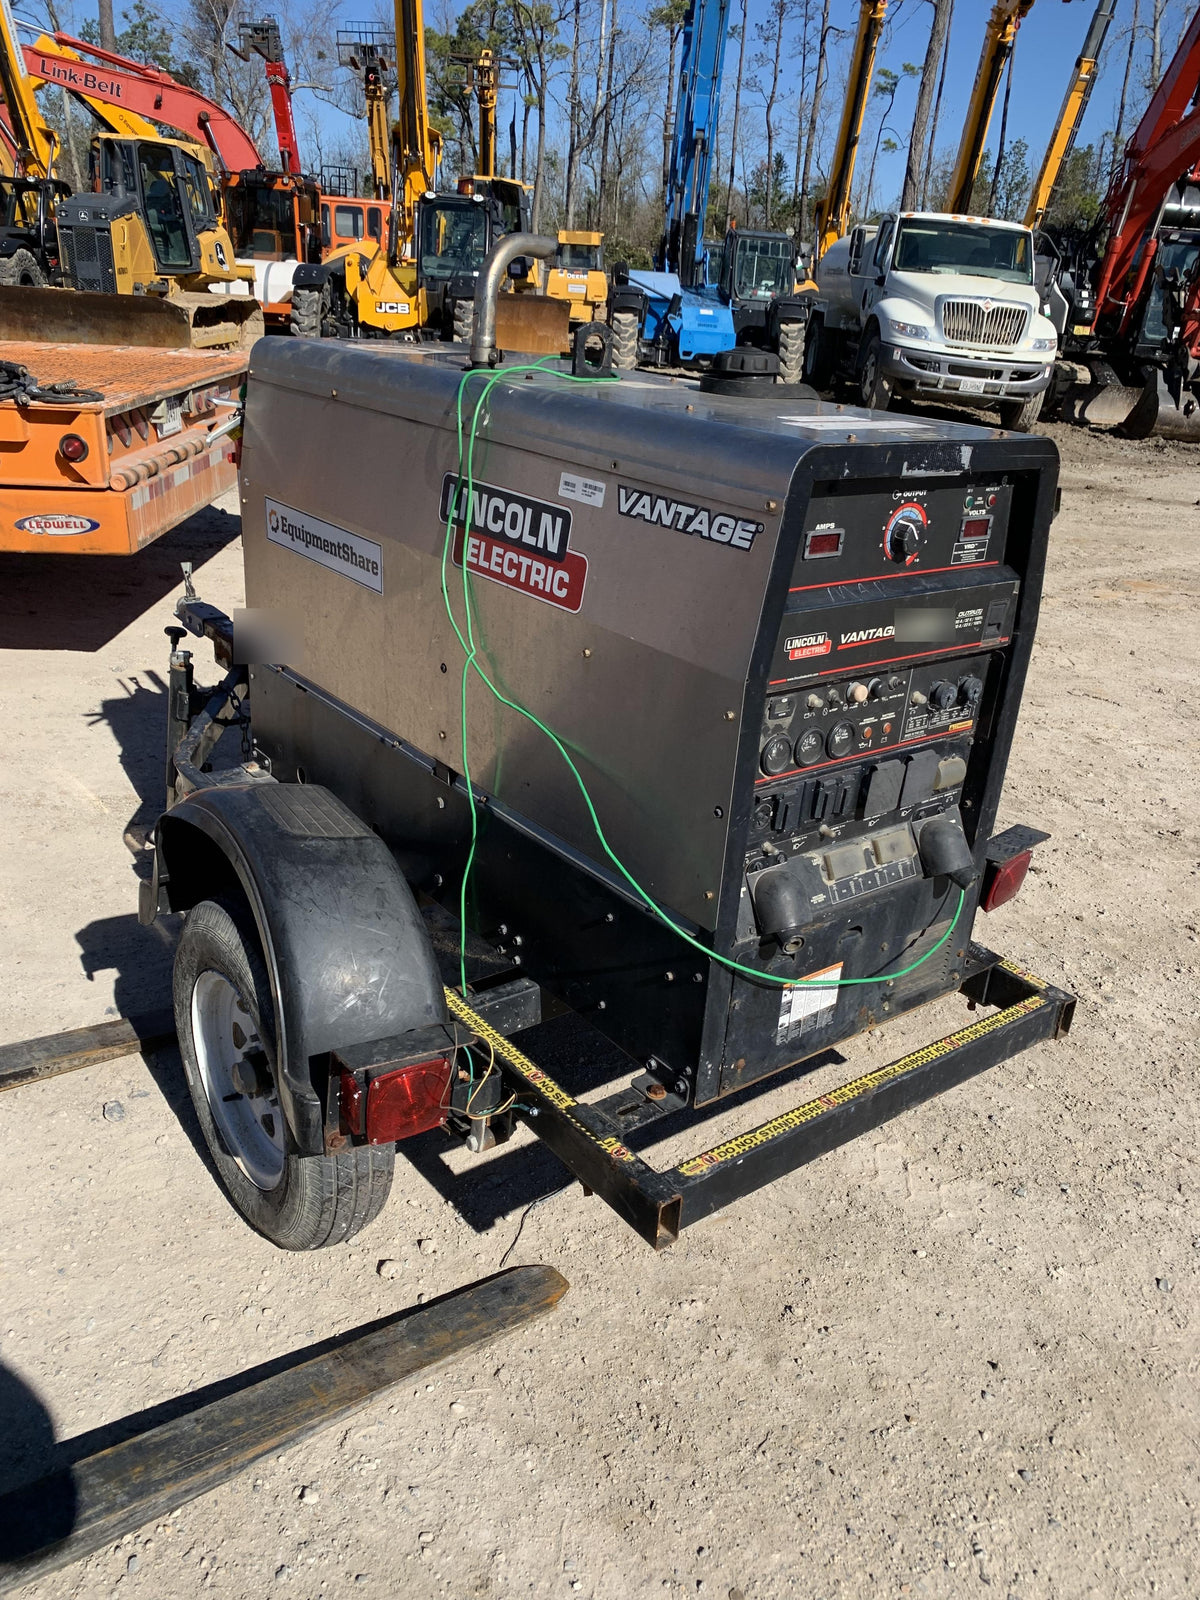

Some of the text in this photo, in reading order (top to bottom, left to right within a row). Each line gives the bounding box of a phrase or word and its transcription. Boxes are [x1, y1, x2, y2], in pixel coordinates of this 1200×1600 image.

[41, 59, 122, 97] Link-Belt
[375, 302, 410, 314] JCB
[28, 521, 86, 529] LEDWELL
[446, 484, 563, 554] LINCOLN
[815, 522, 836, 530] AMPS
[280, 515, 379, 576] EquipmentShare
[466, 537, 570, 598] ELECTRIC
[787, 634, 825, 649] LINCOLN
[794, 645, 828, 657] ELECTRIC
[448, 999, 465, 1013] PAS
[463, 1012, 490, 1033] TENEZ
[486, 1033, 519, 1062] DEBOUT
[517, 1061, 533, 1073] ICI
[955, 1033, 971, 1043] NO
[970, 1026, 982, 1036] SE
[981, 1017, 1002, 1031] PARE
[833, 1045, 949, 1102] NE PAS TENEZ DEBOUT ICI
[540, 1080, 568, 1105] NO SE
[717, 1103, 824, 1159] DO NOT STAND HERE
